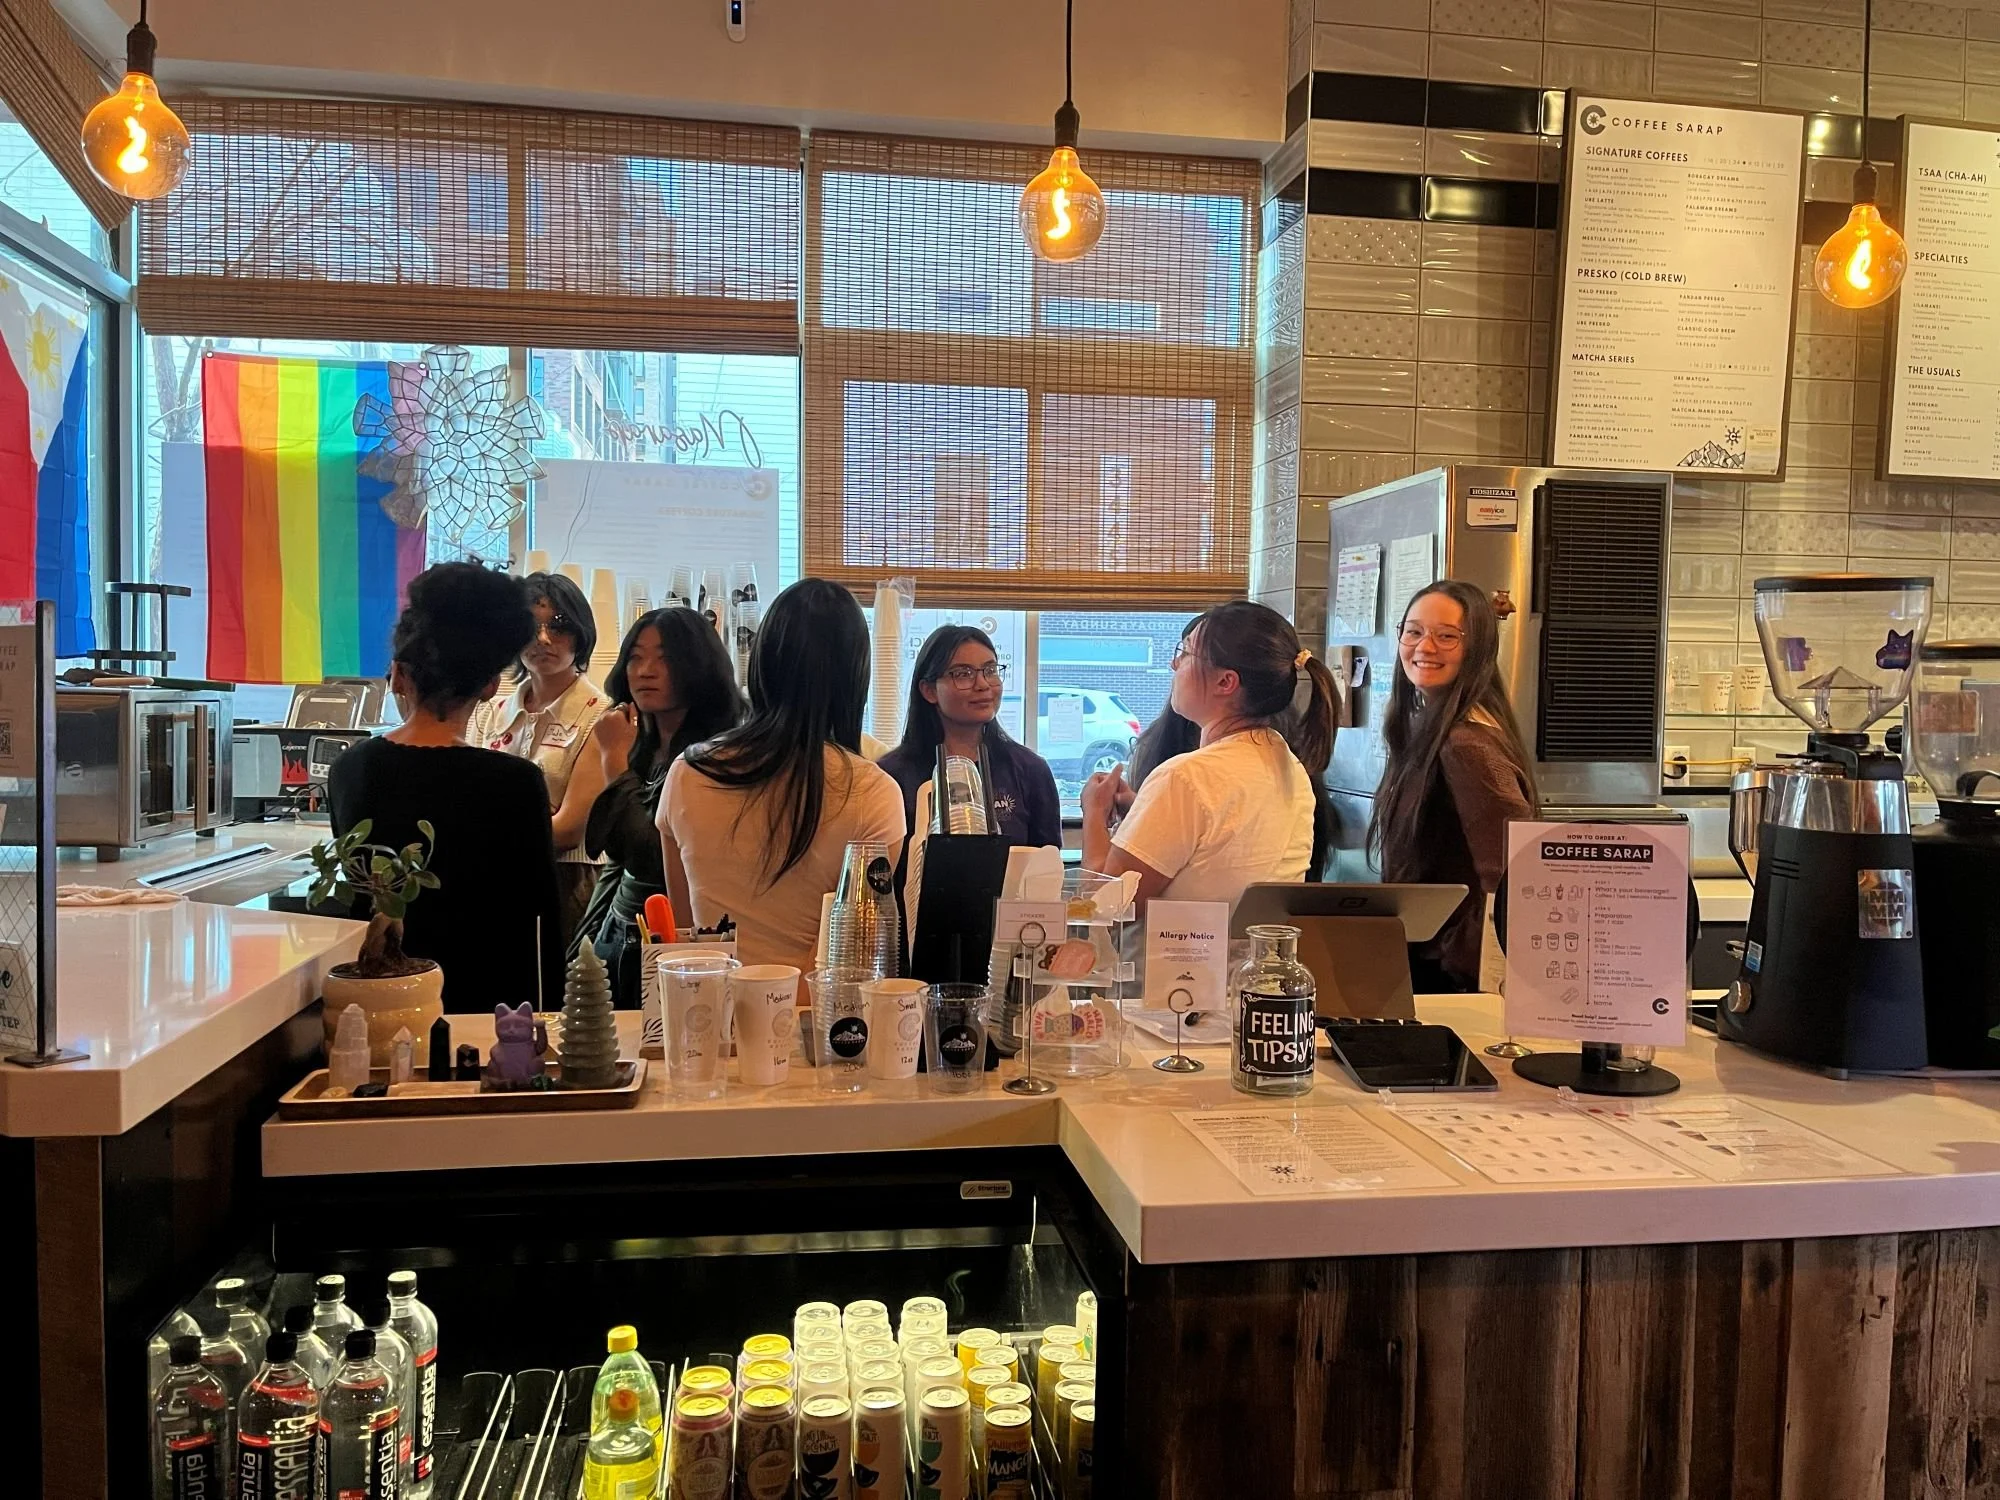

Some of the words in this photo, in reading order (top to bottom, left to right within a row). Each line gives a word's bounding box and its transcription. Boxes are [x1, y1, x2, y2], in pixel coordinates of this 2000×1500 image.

[1611, 117, 1668, 131] COFFEE
[1676, 121, 1724, 136] SARAP
[1586, 146, 1643, 159] SIGNATURE
[1645, 150, 1688, 162] COFFEES
[1918, 167, 1942, 178] TSAA
[1944, 170, 1987, 184] (CHA-AH)
[1914, 251, 1969, 265] SPECIALTIES
[1577, 268, 1618, 281] PRESKO
[1619, 270, 1652, 284] (COLD
[1654, 272, 1688, 286] BREW)
[1572, 353, 1607, 364] MATCHA
[1608, 355, 1636, 365] SERIES
[1907, 365, 1924, 375] THE
[1926, 367, 1961, 378] USUALS
[1471, 488, 1513, 497] HOSHIZAKI
[1543, 846, 1599, 859] COFFEE
[1602, 848, 1651, 860] SARAP
[1159, 932, 1189, 942] Allergy
[1189, 932, 1215, 941] Notice
[833, 1001, 871, 1013] Medium
[897, 998, 918, 1011] Small
[1251, 1010, 1315, 1036] FEELING
[988, 1451, 1030, 1476] MANGO
